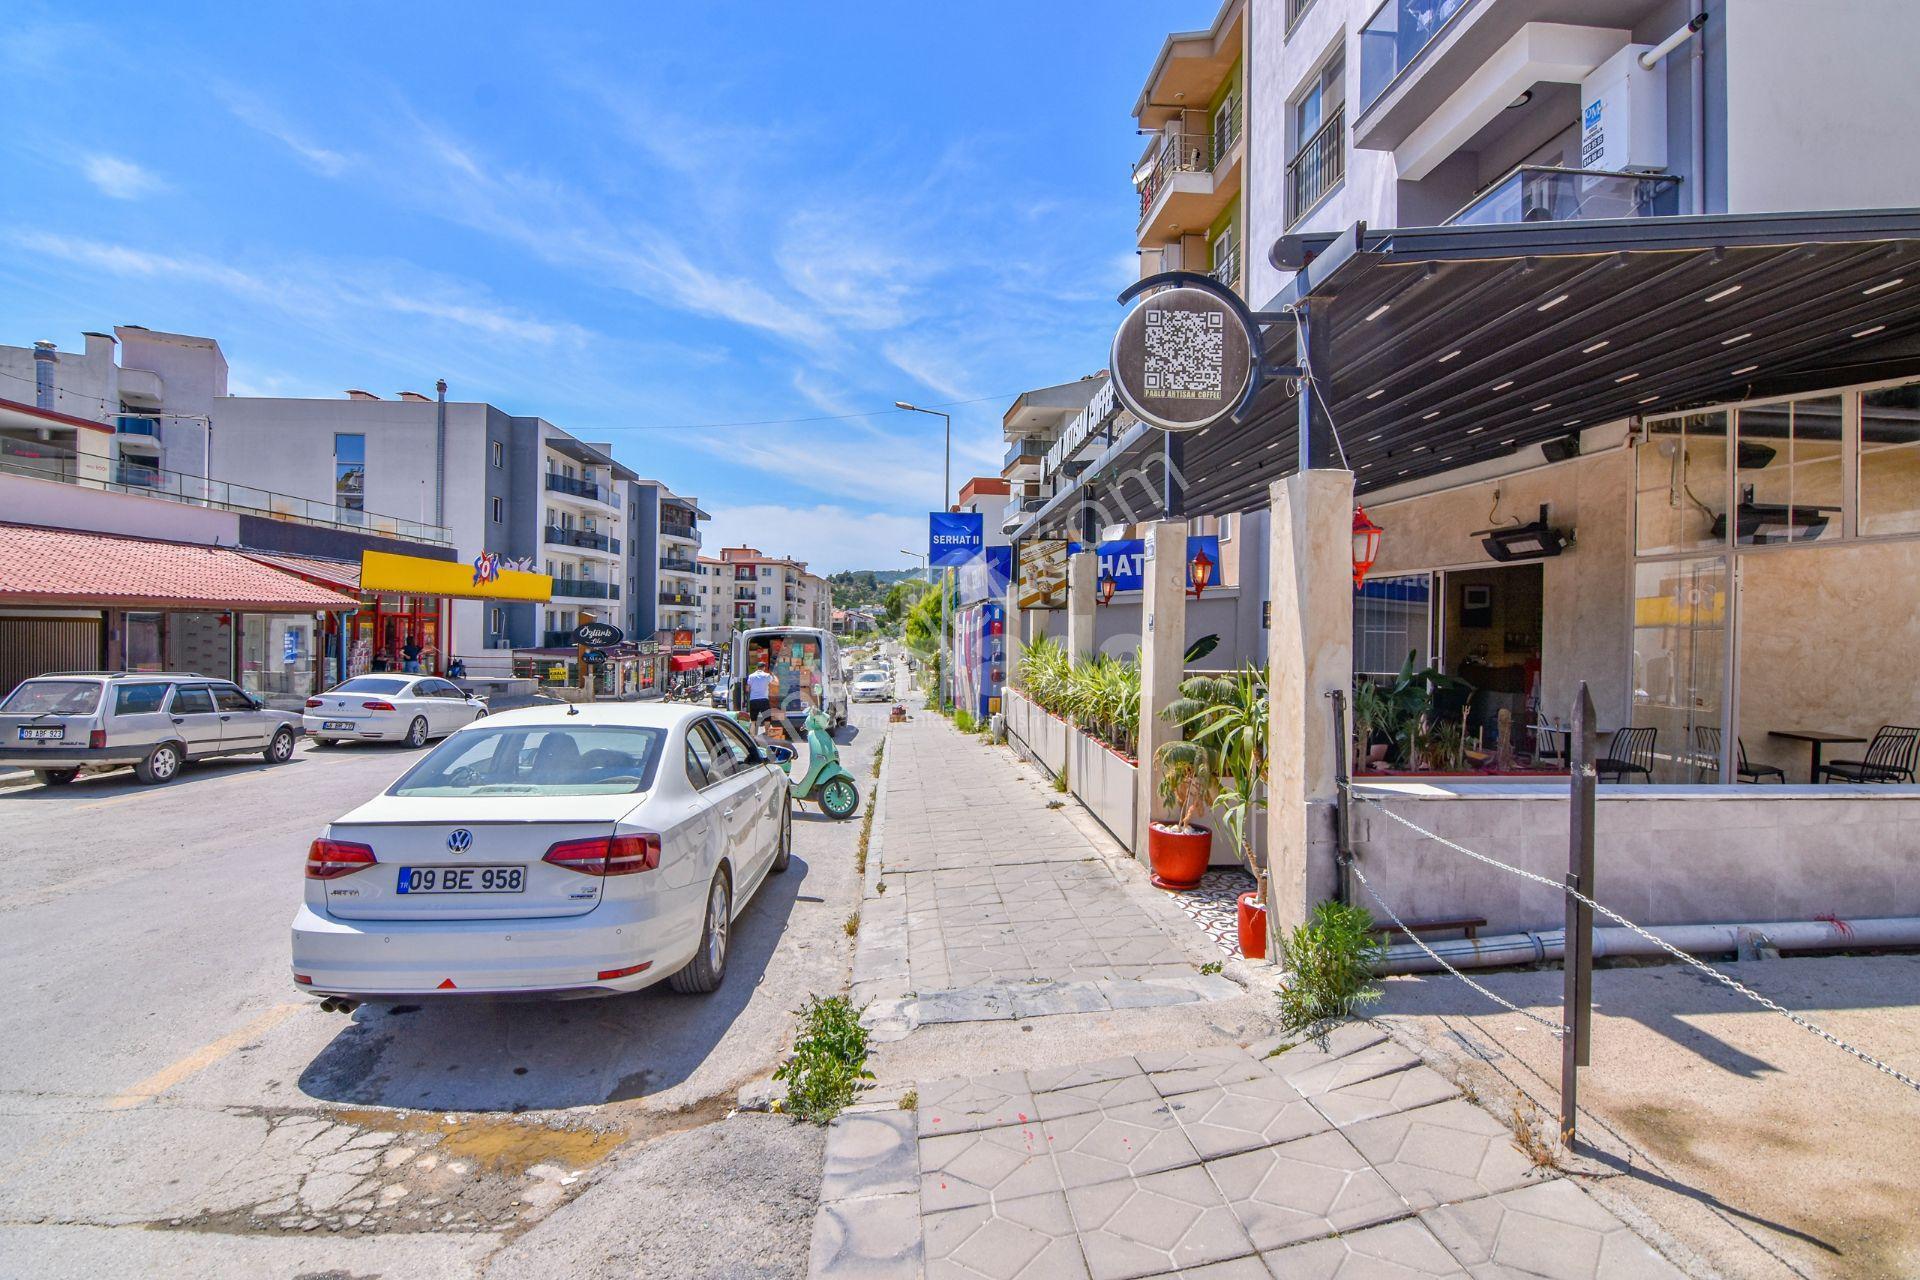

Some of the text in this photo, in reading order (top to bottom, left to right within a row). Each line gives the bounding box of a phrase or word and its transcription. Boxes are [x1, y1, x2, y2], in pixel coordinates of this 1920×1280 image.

[1145, 389, 1220, 399] PABLO ARTISAN COFFEE
[933, 535, 980, 545] SERHAT II
[49, 730, 62, 738] 923
[409, 869, 436, 890] 09
[442, 869, 473, 890] BE
[481, 868, 522, 890] 958
